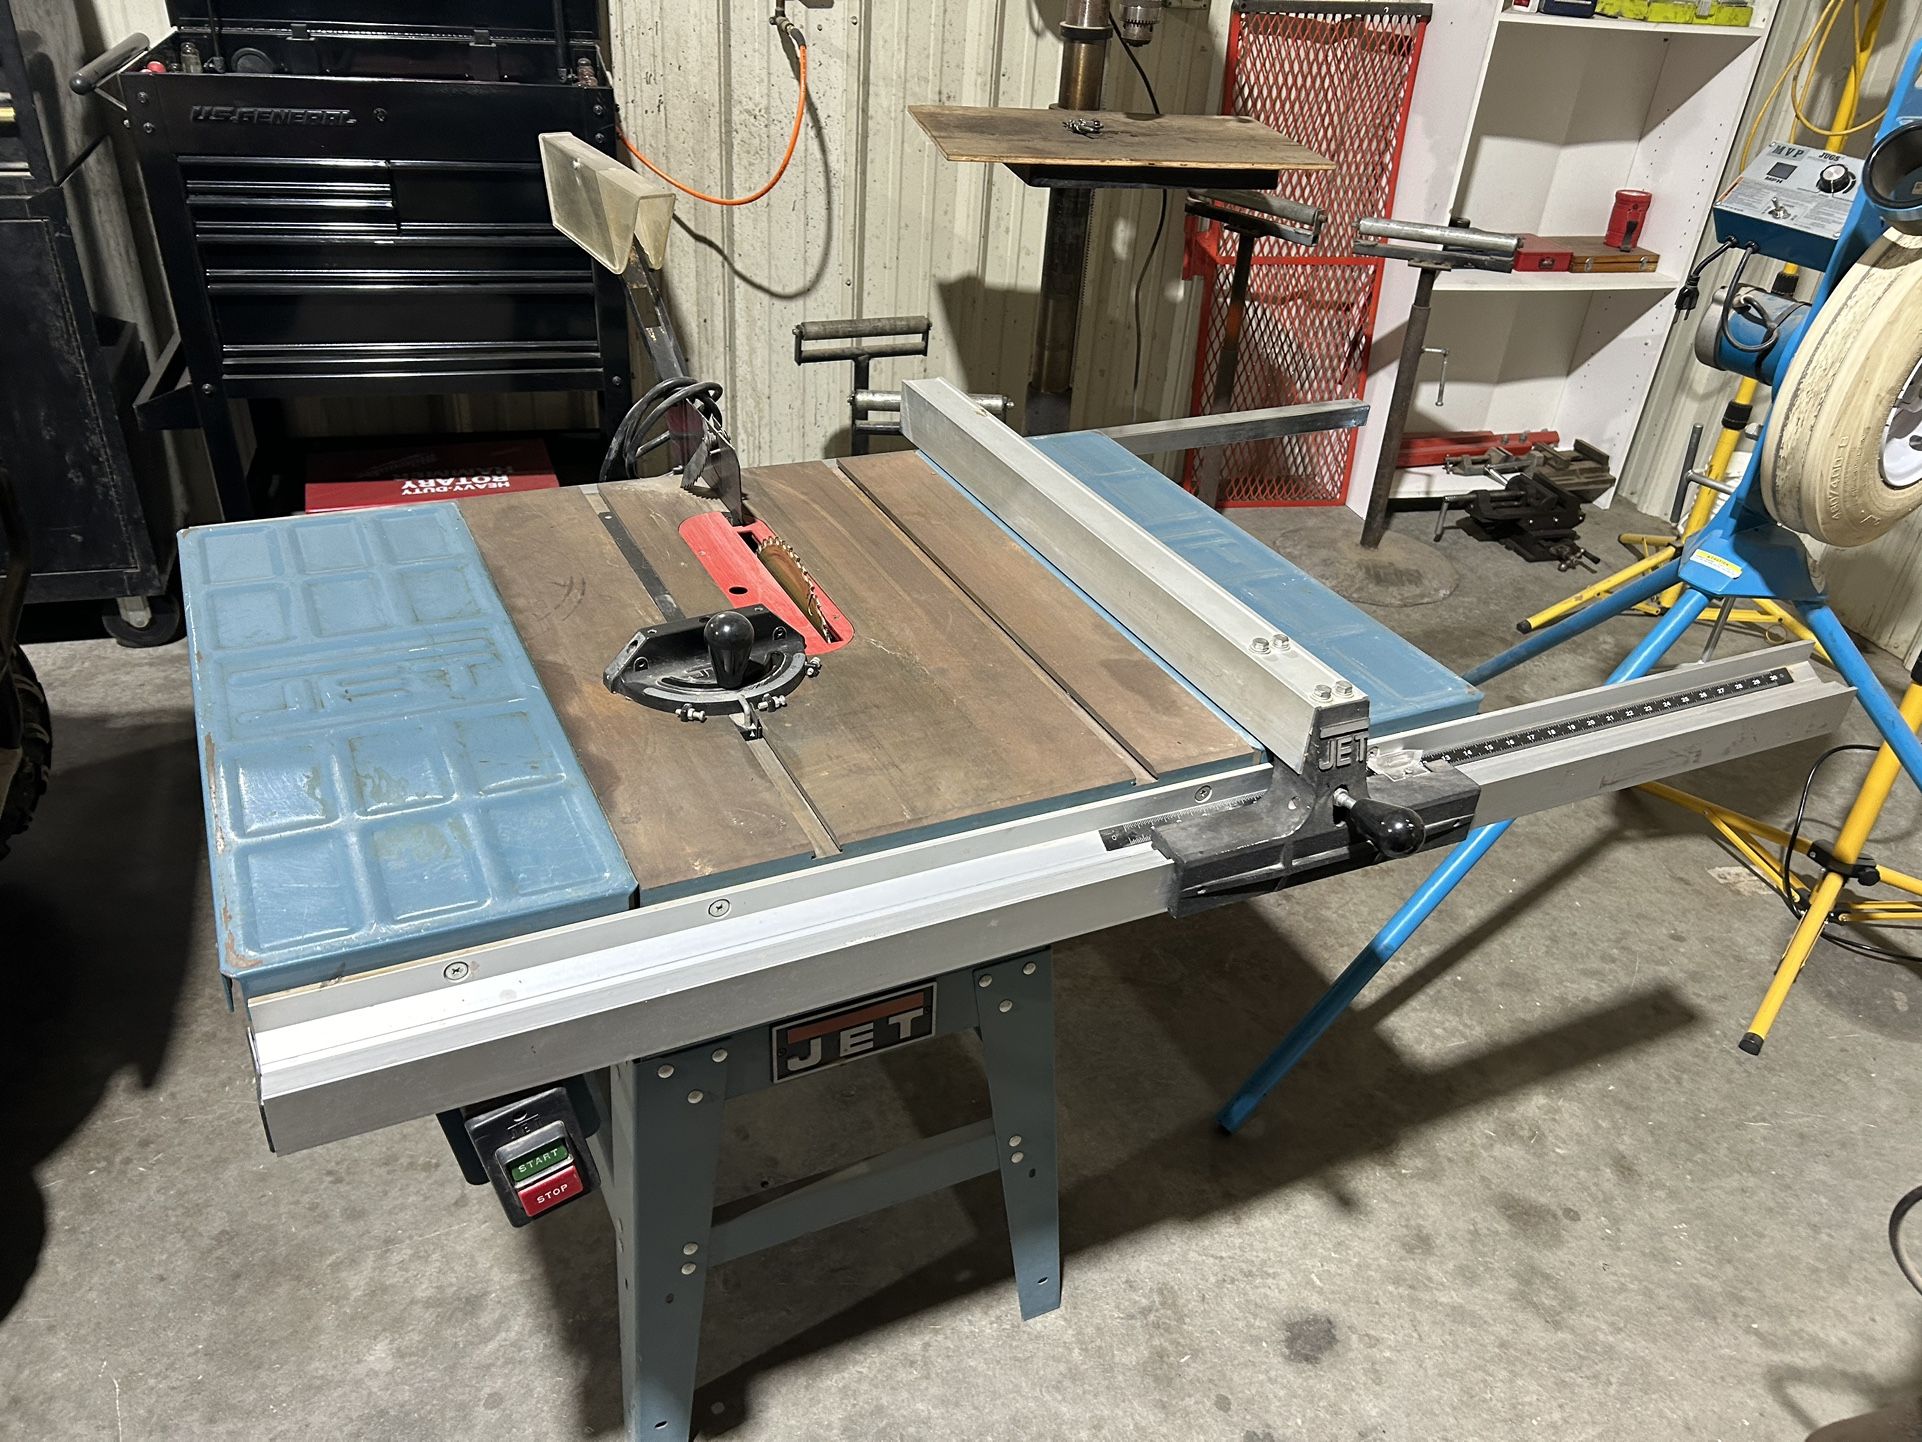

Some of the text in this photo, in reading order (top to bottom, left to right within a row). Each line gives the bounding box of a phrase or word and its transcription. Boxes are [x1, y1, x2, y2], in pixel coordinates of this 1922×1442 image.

[1771, 144, 1805, 158] MVP
[1818, 152, 1840, 162] JUGS
[1764, 176, 1783, 184] MPH
[401, 475, 509, 489] ROTARY
[401, 480, 511, 496] HEAVY-DUTY
[1463, 749, 1473, 757] 14
[1485, 743, 1494, 751] 15
[1505, 738, 1515, 746] 16
[1526, 733, 1536, 741] 17
[1567, 723, 1577, 731] 19
[1586, 719, 1596, 727] 20
[1606, 714, 1615, 722] 21
[1752, 678, 1761, 686] 29
[1318, 731, 1369, 772] JET
[787, 1007, 924, 1072] JET
[517, 1148, 559, 1173] START
[536, 1183, 569, 1204] STOP
